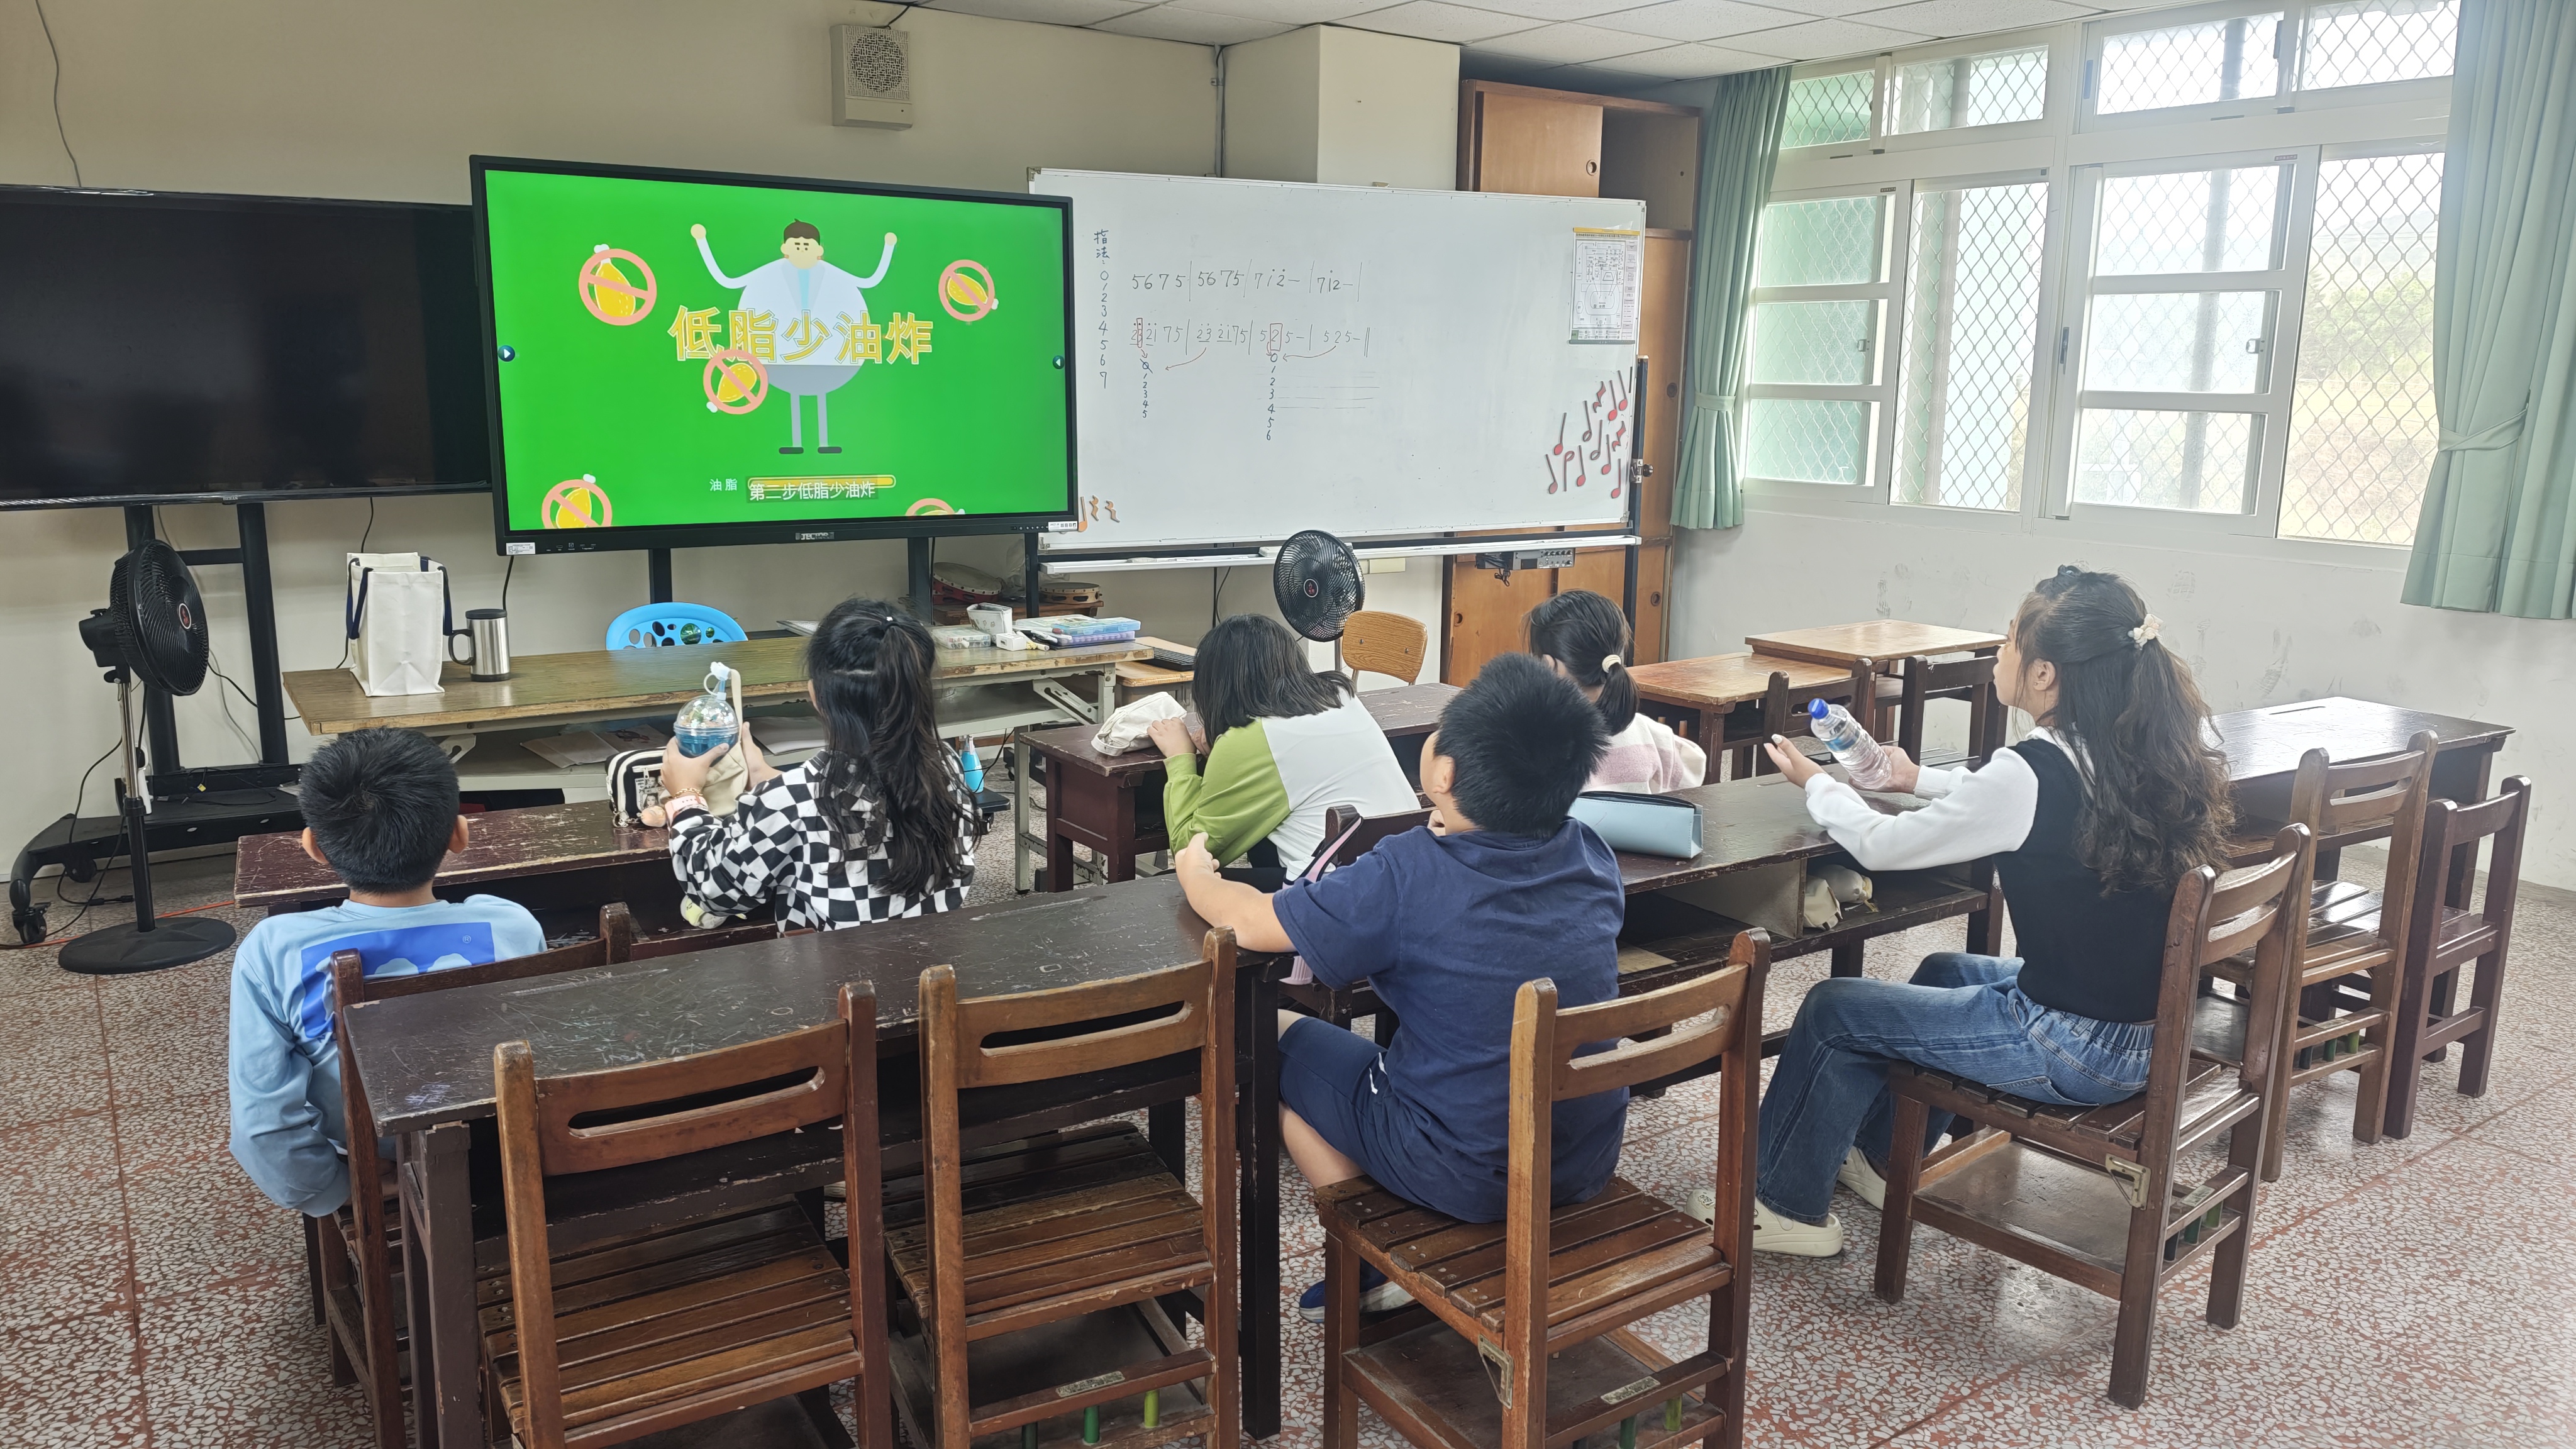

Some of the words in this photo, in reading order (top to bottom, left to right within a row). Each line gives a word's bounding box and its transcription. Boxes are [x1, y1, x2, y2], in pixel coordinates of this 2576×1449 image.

[667, 304, 933, 364] 低脂少油炸
[709, 478, 738, 491] 油脂
[750, 480, 875, 501] 第二步低脂少油炸
